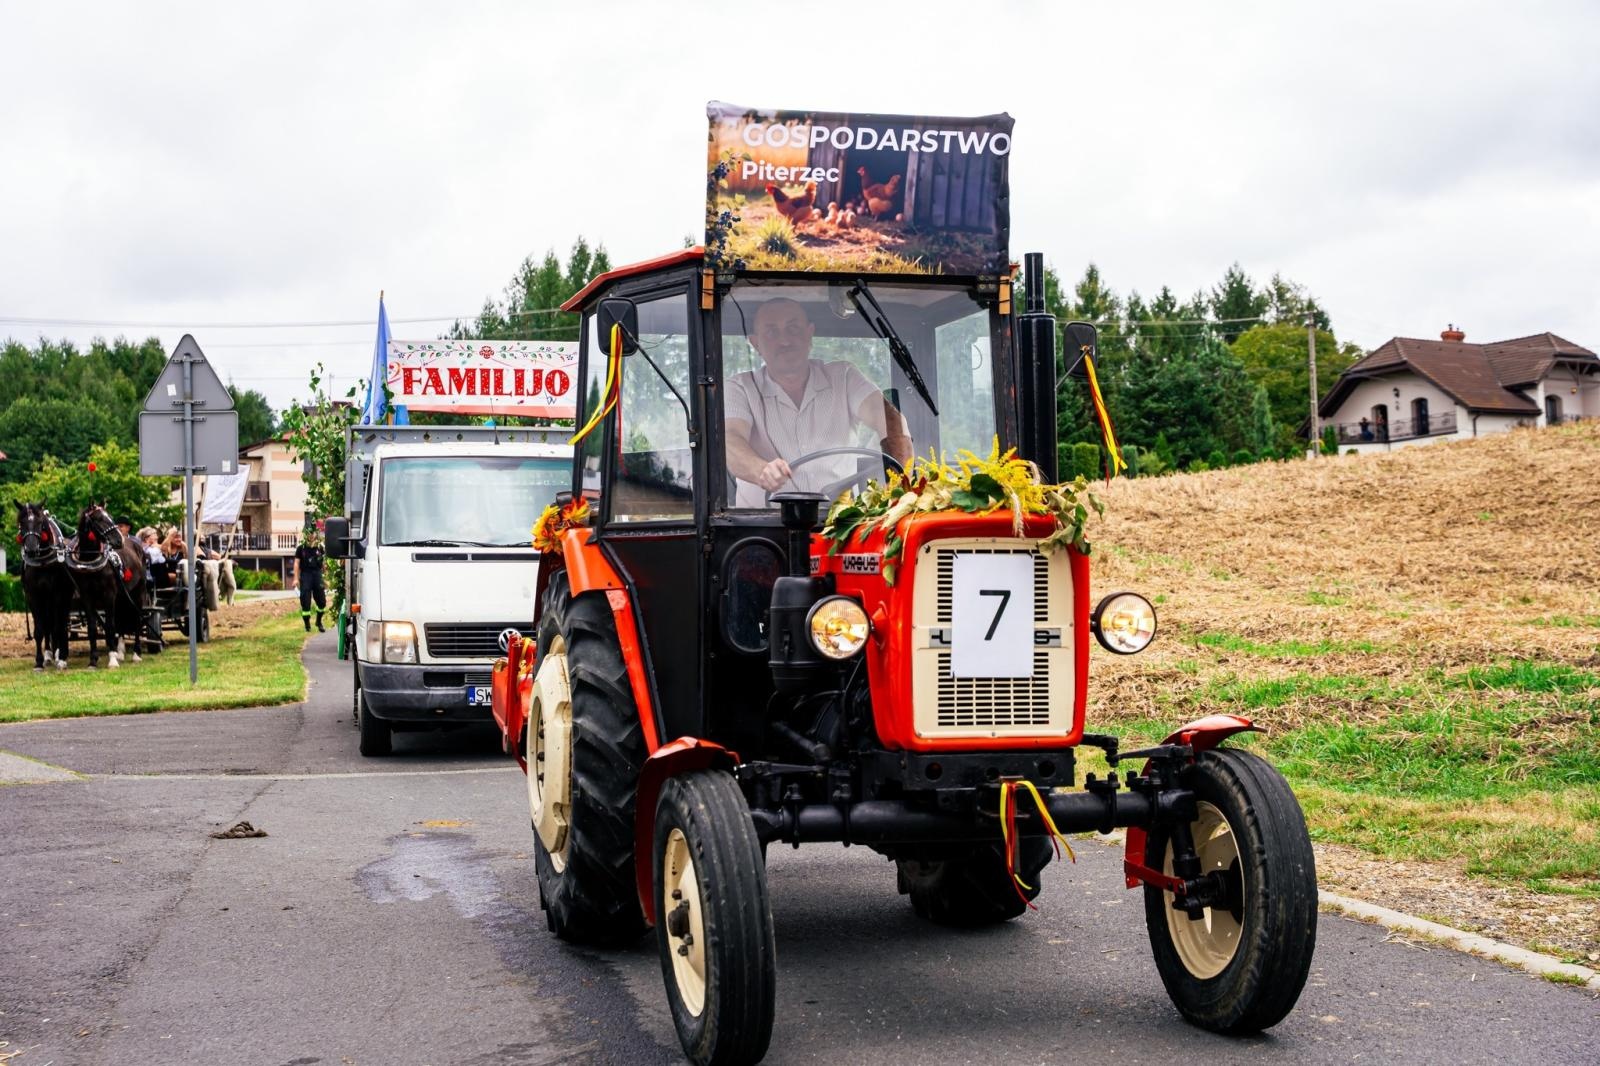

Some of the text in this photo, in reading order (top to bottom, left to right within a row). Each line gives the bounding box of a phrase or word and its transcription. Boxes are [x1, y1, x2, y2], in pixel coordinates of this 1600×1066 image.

[742, 123, 1011, 156] GOSPODARSTWO
[742, 160, 840, 183] Piterzec
[402, 367, 570, 397] FAMILIJO
[979, 590, 1011, 641] 7
